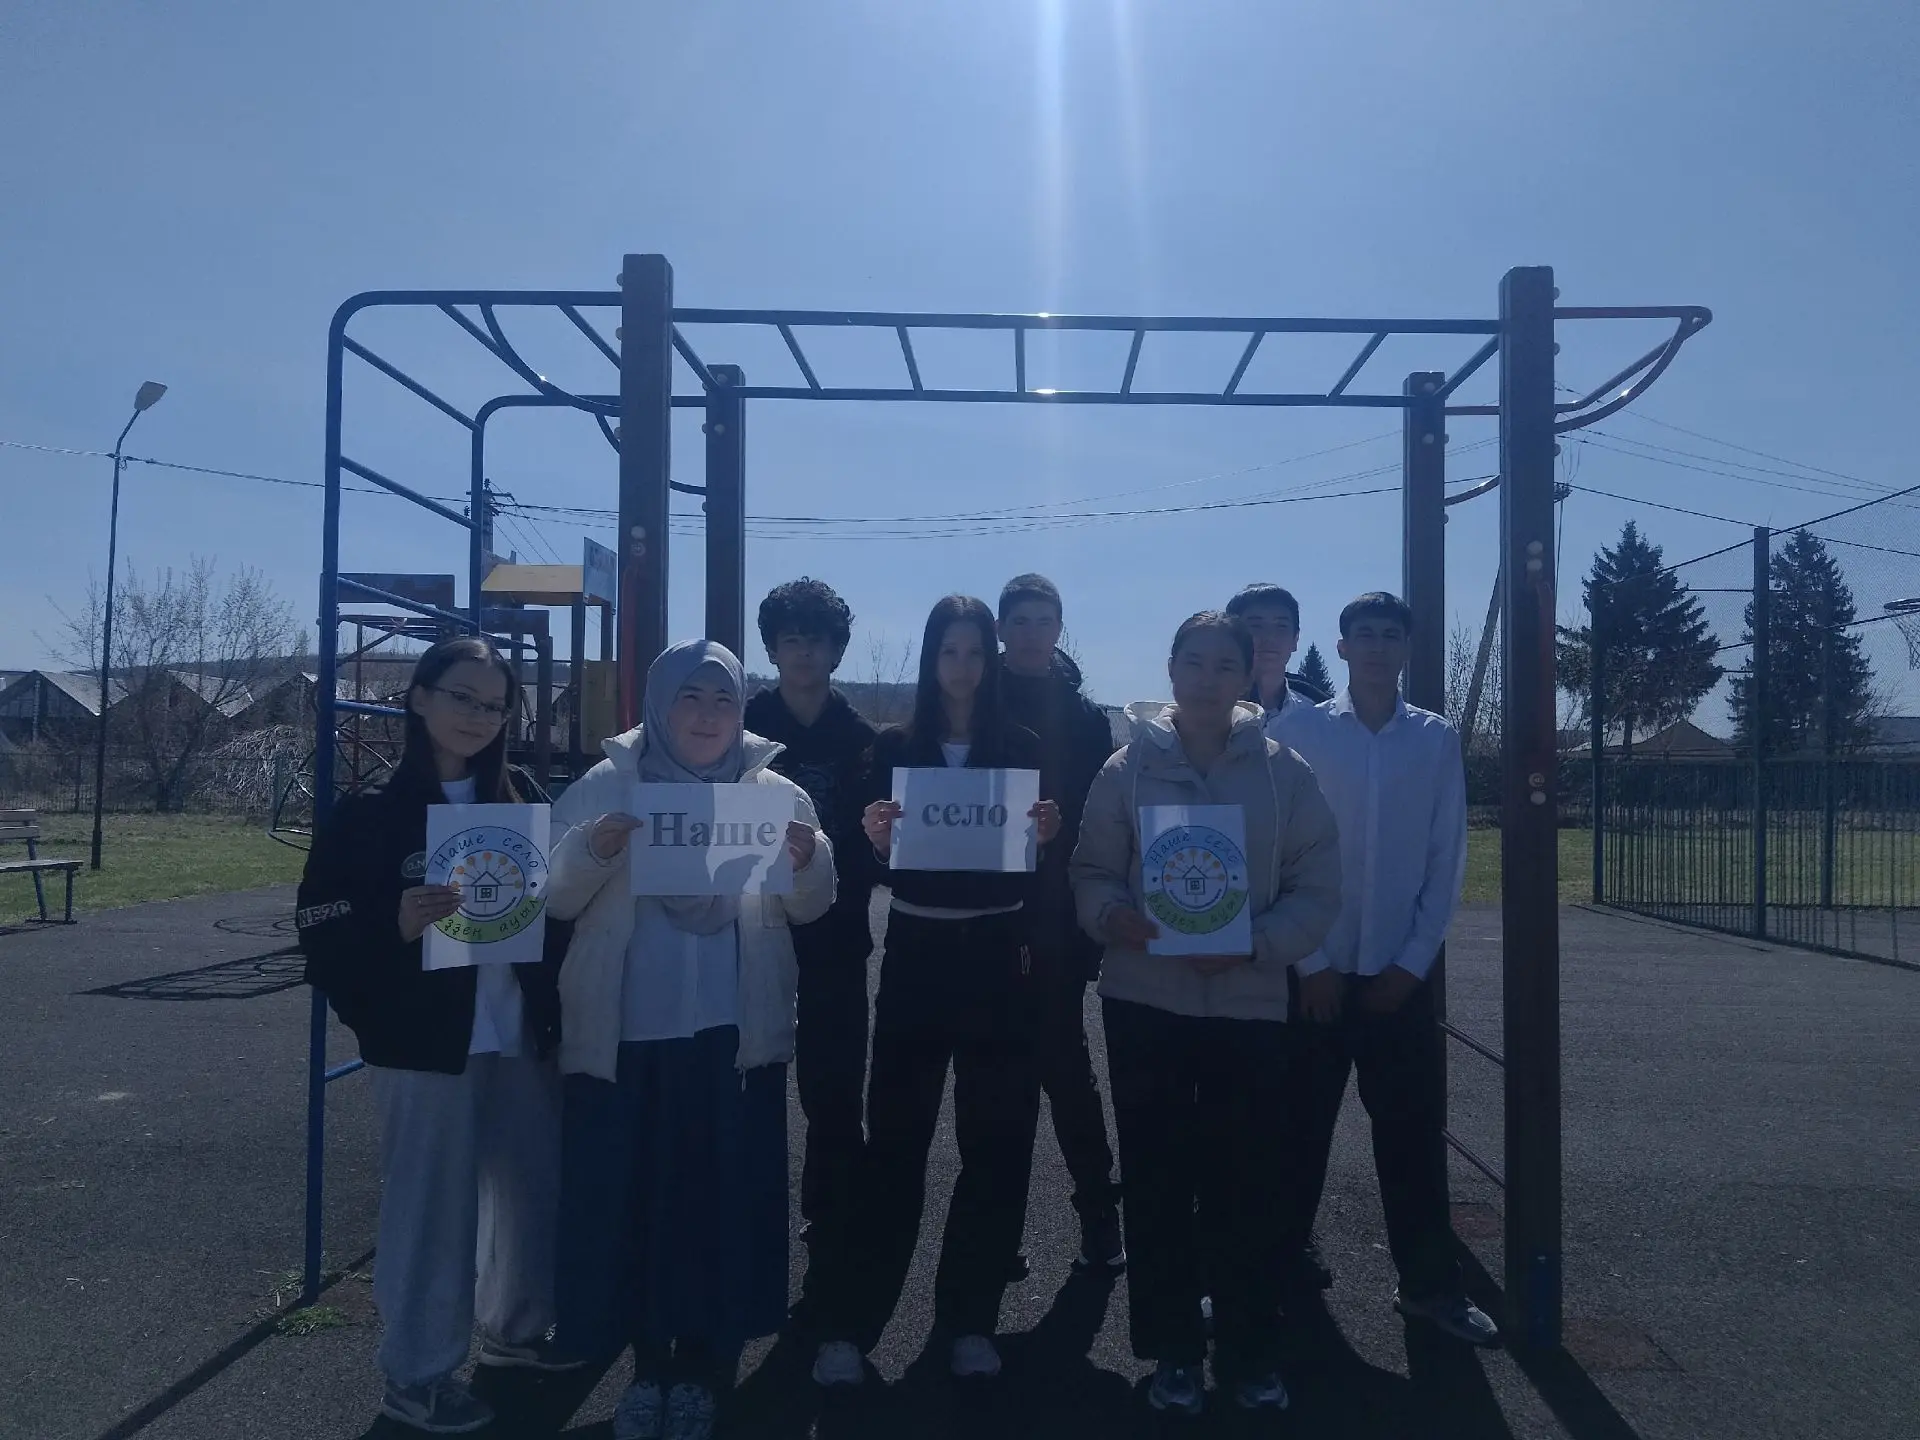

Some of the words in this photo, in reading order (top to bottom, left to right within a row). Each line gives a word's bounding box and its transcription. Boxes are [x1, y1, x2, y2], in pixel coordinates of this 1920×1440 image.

[648, 811, 778, 848] Наше
[921, 801, 1009, 828] село
[435, 834, 486, 870] Наше
[502, 837, 539, 868] село
[1149, 832, 1191, 864] Наше
